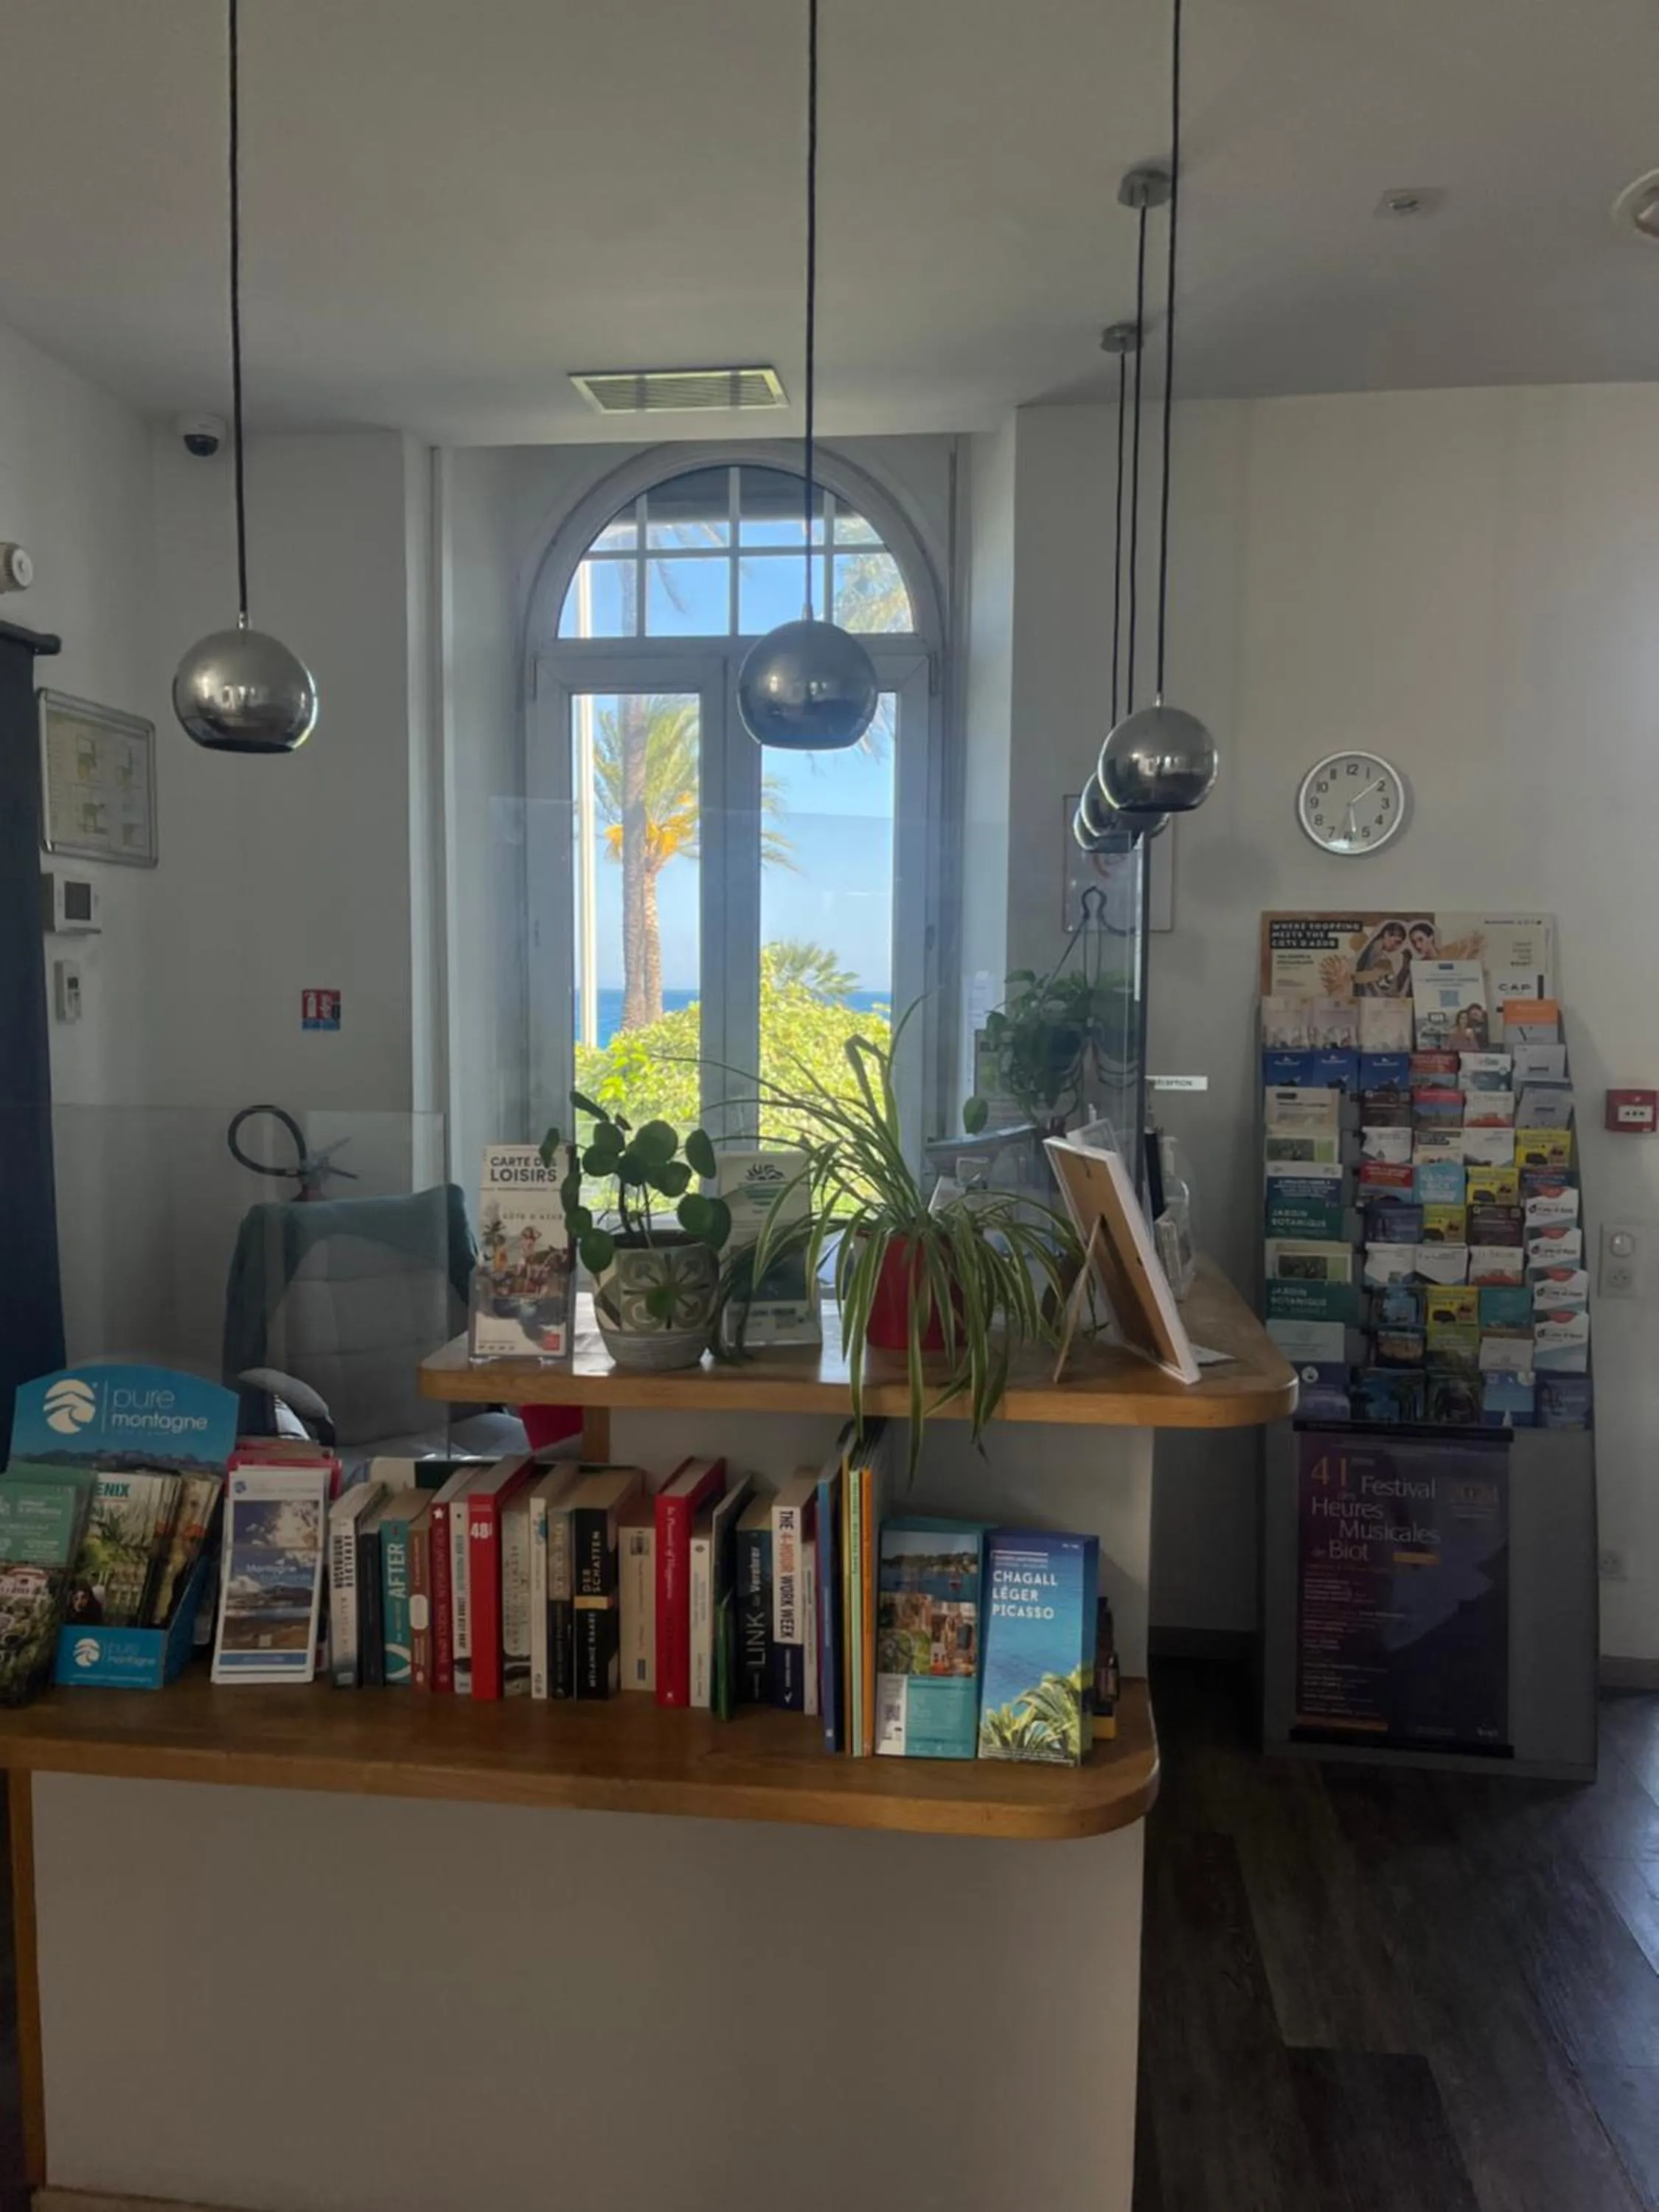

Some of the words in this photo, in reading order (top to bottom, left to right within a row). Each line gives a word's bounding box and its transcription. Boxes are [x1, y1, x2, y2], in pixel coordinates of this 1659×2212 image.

[1346, 763, 1360, 776] 12
[1365, 767, 1371, 779] 1
[1316, 780, 1329, 793] 10
[1375, 780, 1386, 793] 2
[1309, 796, 1320, 810] 9
[1381, 797, 1391, 810] 3
[1314, 813, 1324, 827] 8
[1374, 814, 1384, 826] 4
[1326, 825, 1336, 838] 7
[1361, 826, 1371, 838] 5
[490, 1156, 531, 1167] CARTE
[490, 1168, 557, 1183] LOISIRS
[112, 1389, 176, 1411] pure
[111, 1409, 209, 1435] montagne
[1360, 1475, 1437, 1500] Festival
[1311, 1495, 1385, 1520] Heures
[779, 1509, 794, 1531] THE
[1338, 1518, 1442, 1545] Musicales
[1328, 1538, 1370, 1562] Biot
[591, 1530, 602, 1593] SCHATTEN
[386, 1541, 408, 1599] AFTER
[992, 1570, 1059, 1587] CHAGALL
[780, 1575, 794, 1607] WORK
[992, 1585, 1038, 1601] LÉGER
[992, 1604, 1055, 1620] PICASSO
[779, 1608, 794, 1640] WEEK
[745, 1610, 767, 1666] LINK
